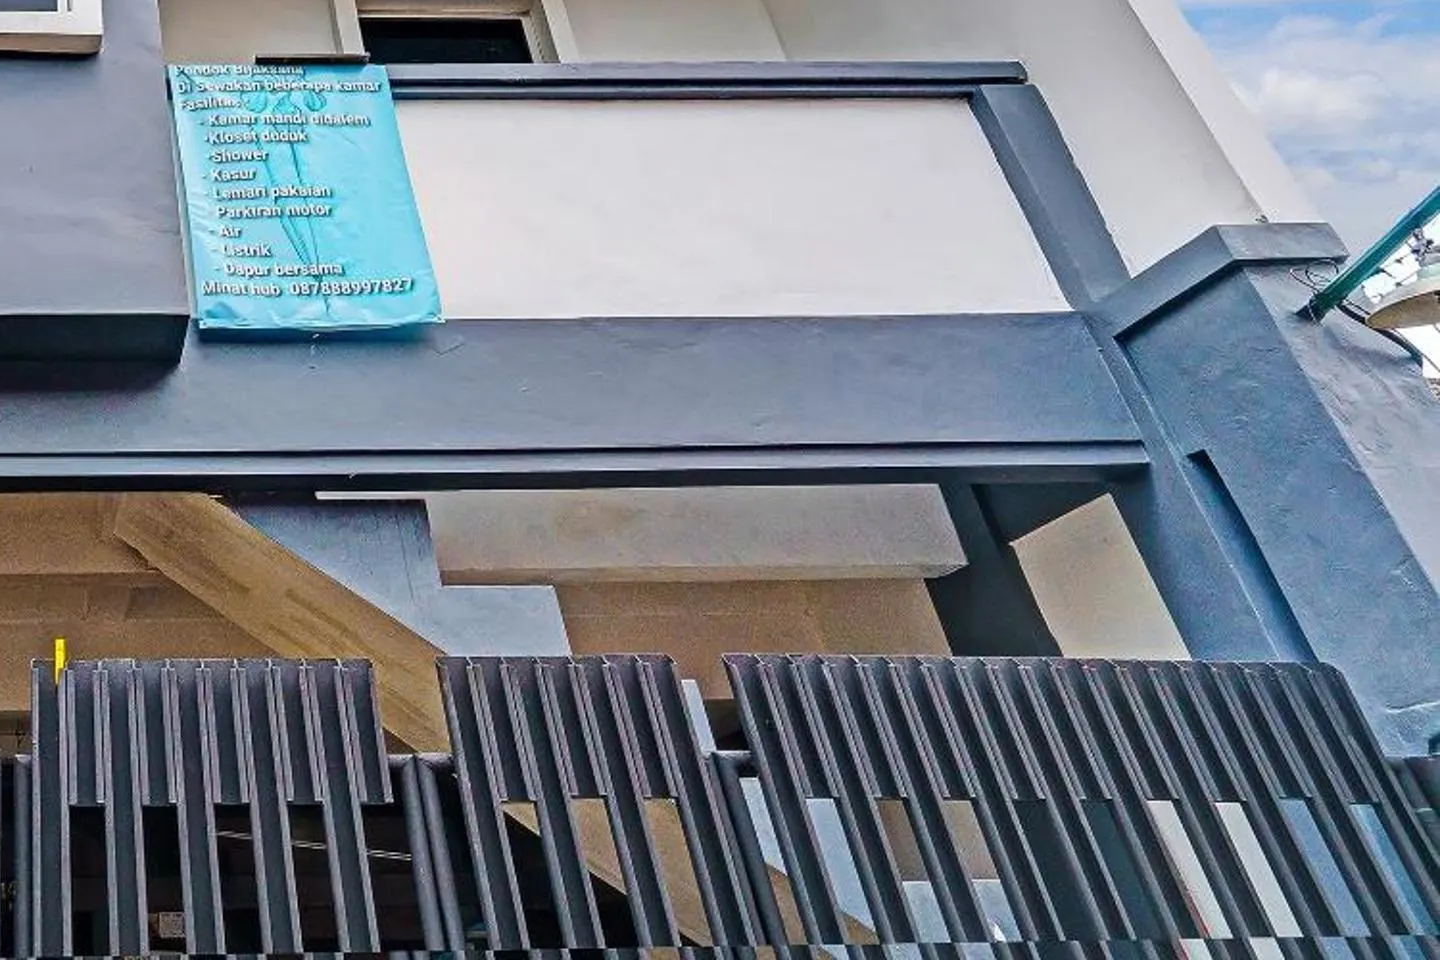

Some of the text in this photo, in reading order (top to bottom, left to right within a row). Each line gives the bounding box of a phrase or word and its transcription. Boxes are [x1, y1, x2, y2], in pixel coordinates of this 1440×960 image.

[335, 81, 381, 92] kamar
[208, 114, 257, 126] Kamar
[263, 113, 307, 125] mandi
[208, 130, 309, 145] Kloset duduk
[211, 147, 269, 162] Shower
[211, 168, 257, 181] Kasur
[212, 184, 333, 200] Lemari pakaian
[216, 204, 333, 218] Parkiran motor
[219, 224, 242, 238] Air
[222, 242, 273, 257] Listrik
[223, 262, 345, 279] Dapur bersama
[202, 281, 249, 295] Minat
